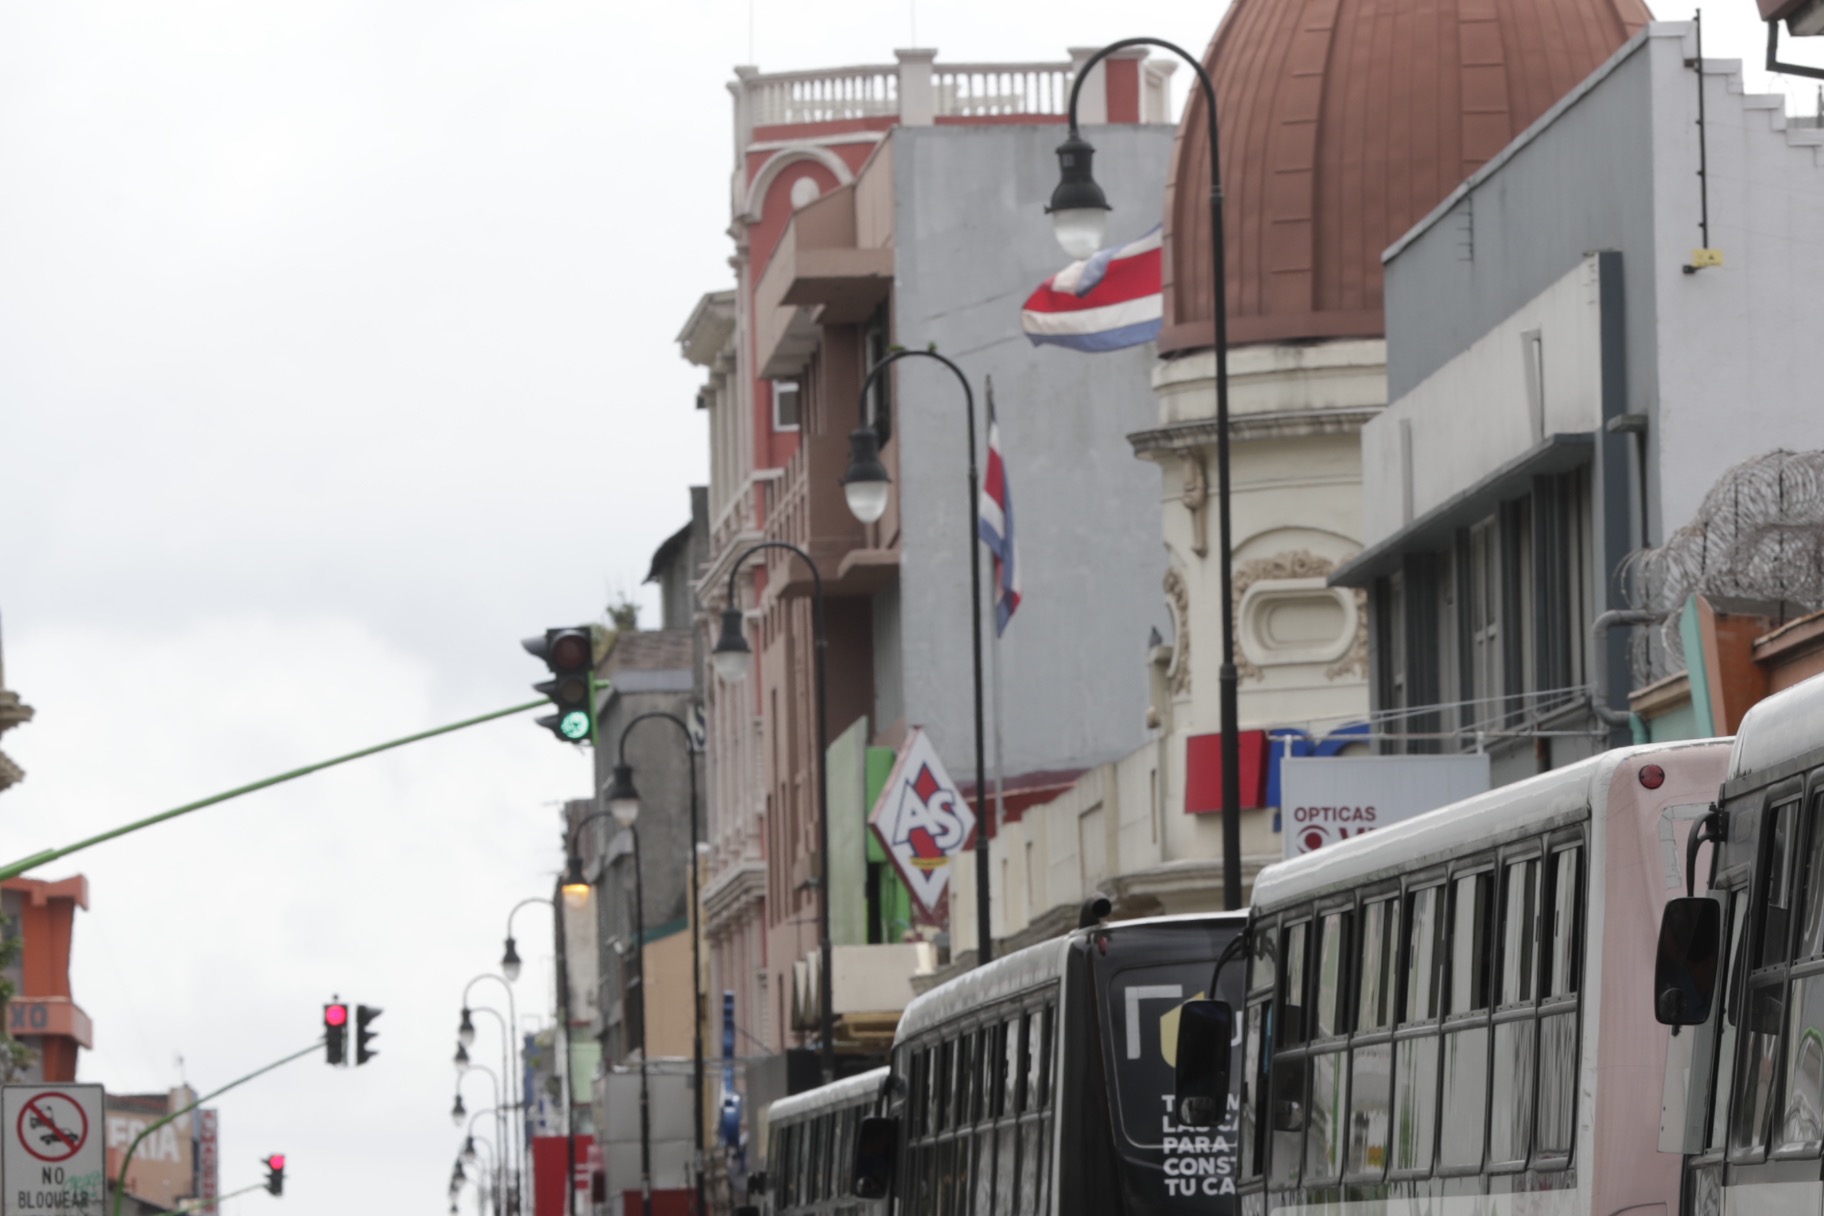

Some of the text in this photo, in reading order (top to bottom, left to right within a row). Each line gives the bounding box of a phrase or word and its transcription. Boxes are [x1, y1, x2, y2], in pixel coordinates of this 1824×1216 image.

[892, 777, 963, 850] AS
[1294, 806, 1376, 822] OPTICAS
[1163, 1136, 1230, 1154] PARA
[42, 1167, 64, 1185] NO
[1164, 1178, 1197, 1196] TU
[18, 1191, 89, 1209] BLOQUEAR
